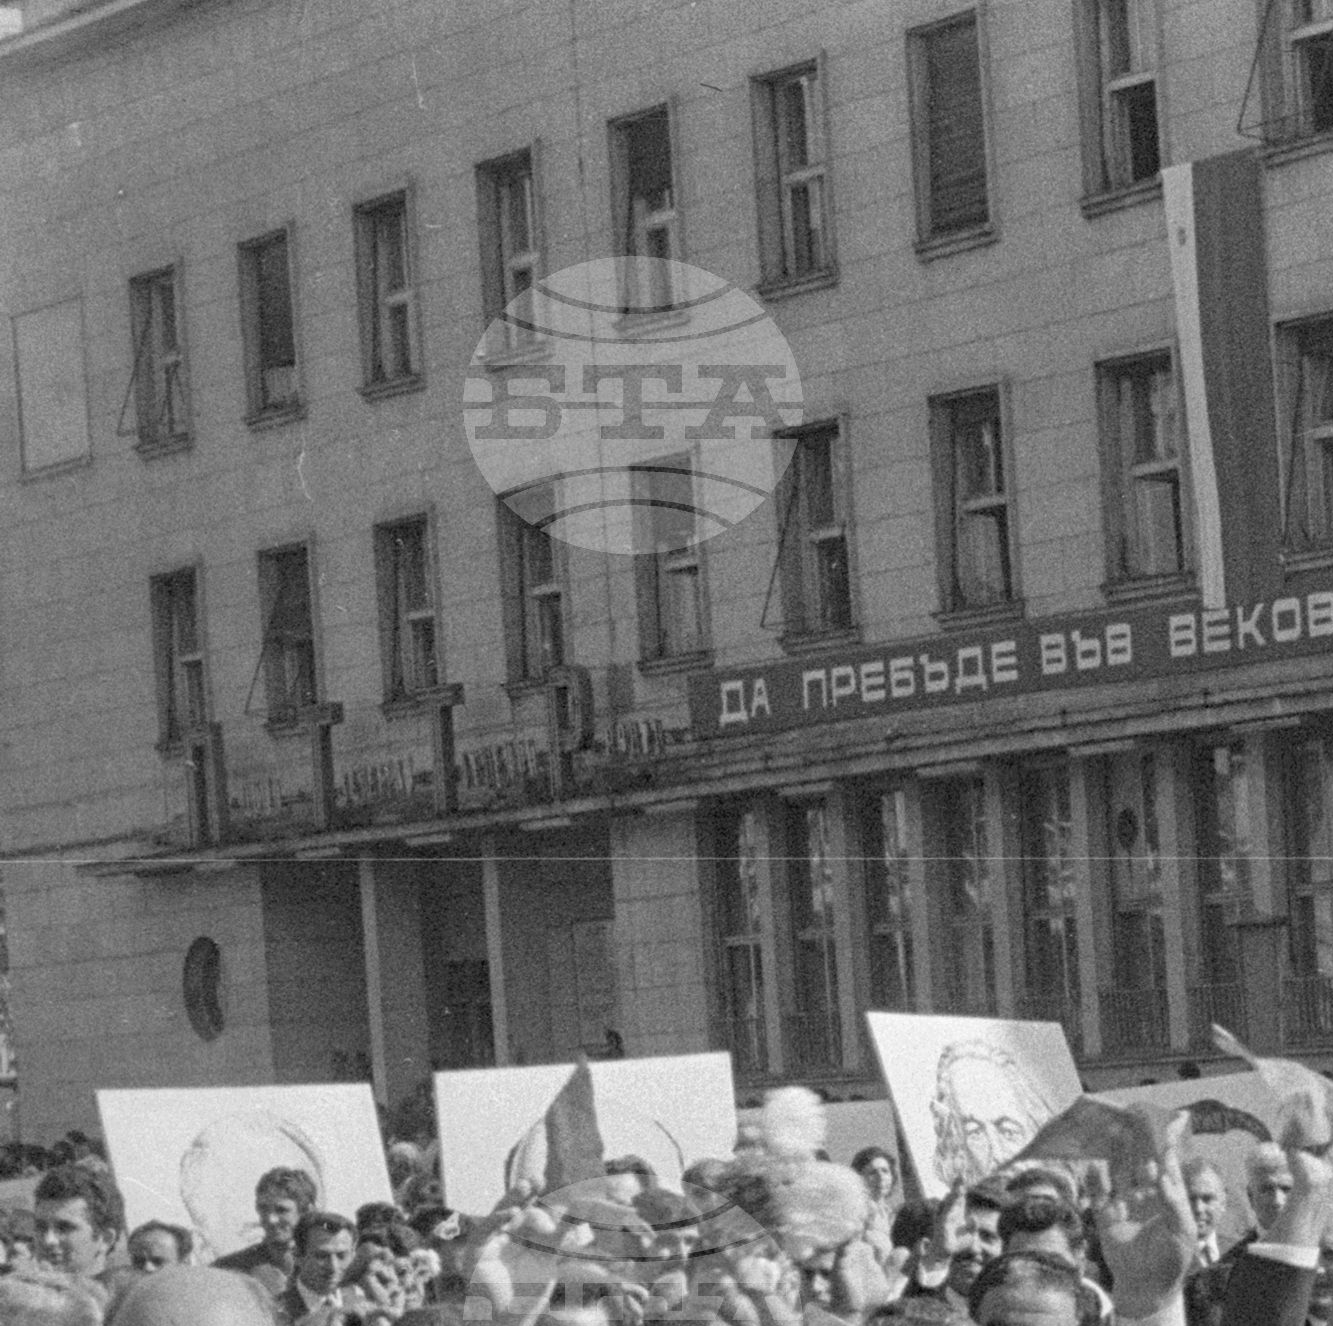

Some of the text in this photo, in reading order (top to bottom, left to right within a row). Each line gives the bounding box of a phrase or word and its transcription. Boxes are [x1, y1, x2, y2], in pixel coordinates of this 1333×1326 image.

[719, 679, 772, 729] ДА
[801, 640, 1017, 710] ПРЕБЪДЕ
[1040, 623, 1134, 674] ВЪВ
